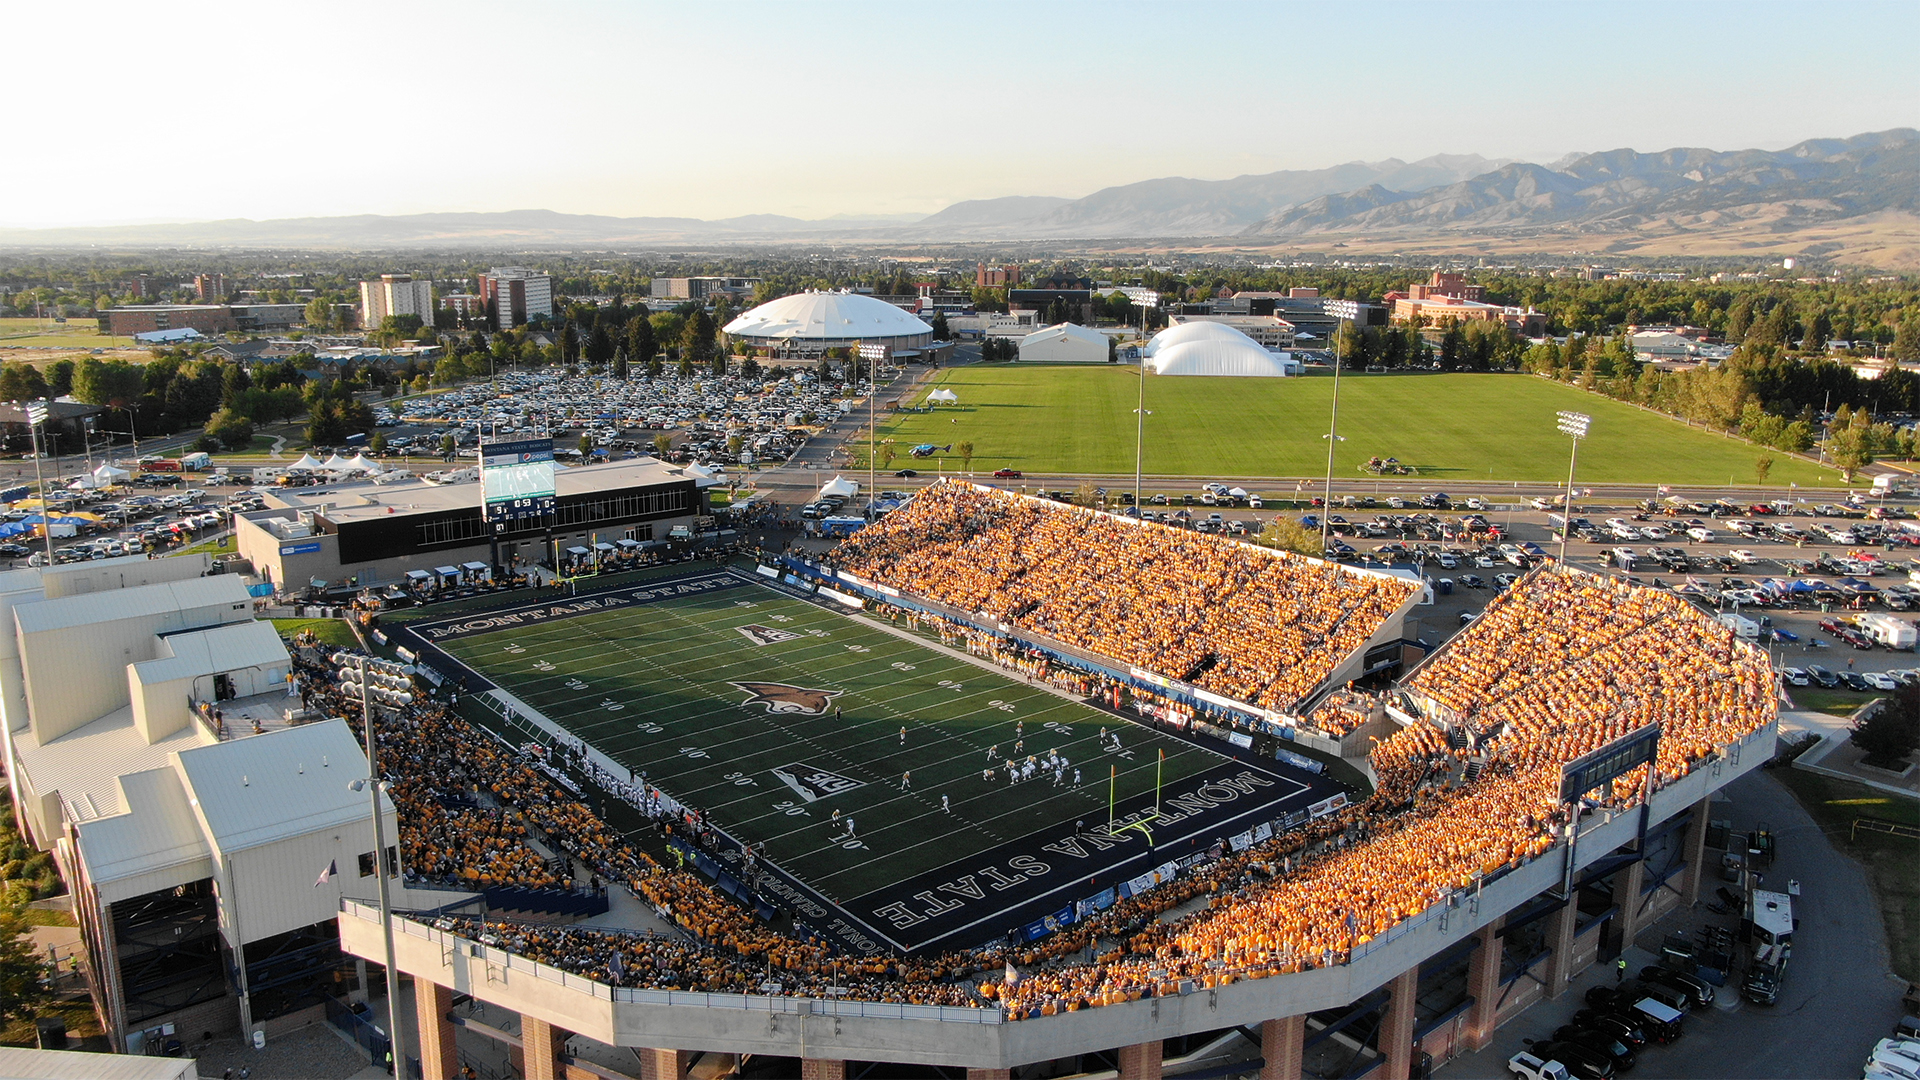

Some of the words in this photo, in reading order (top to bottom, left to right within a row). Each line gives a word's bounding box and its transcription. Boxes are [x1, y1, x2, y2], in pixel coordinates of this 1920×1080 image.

[529, 441, 551, 449] BOBCATS
[531, 452, 549, 460] pepsi
[427, 597, 630, 638] MONTANA
[632, 576, 741, 600] STATE
[565, 678, 589, 690] 30
[1170, 680, 1190, 692] Carrier
[599, 697, 625, 711] 40
[637, 721, 664, 734] 50
[678, 746, 707, 759] 40
[723, 771, 753, 786] 30
[803, 772, 857, 792] SKY
[772, 800, 805, 817] 20
[1042, 770, 1276, 859] MONTANA
[872, 854, 1052, 930] STATE
